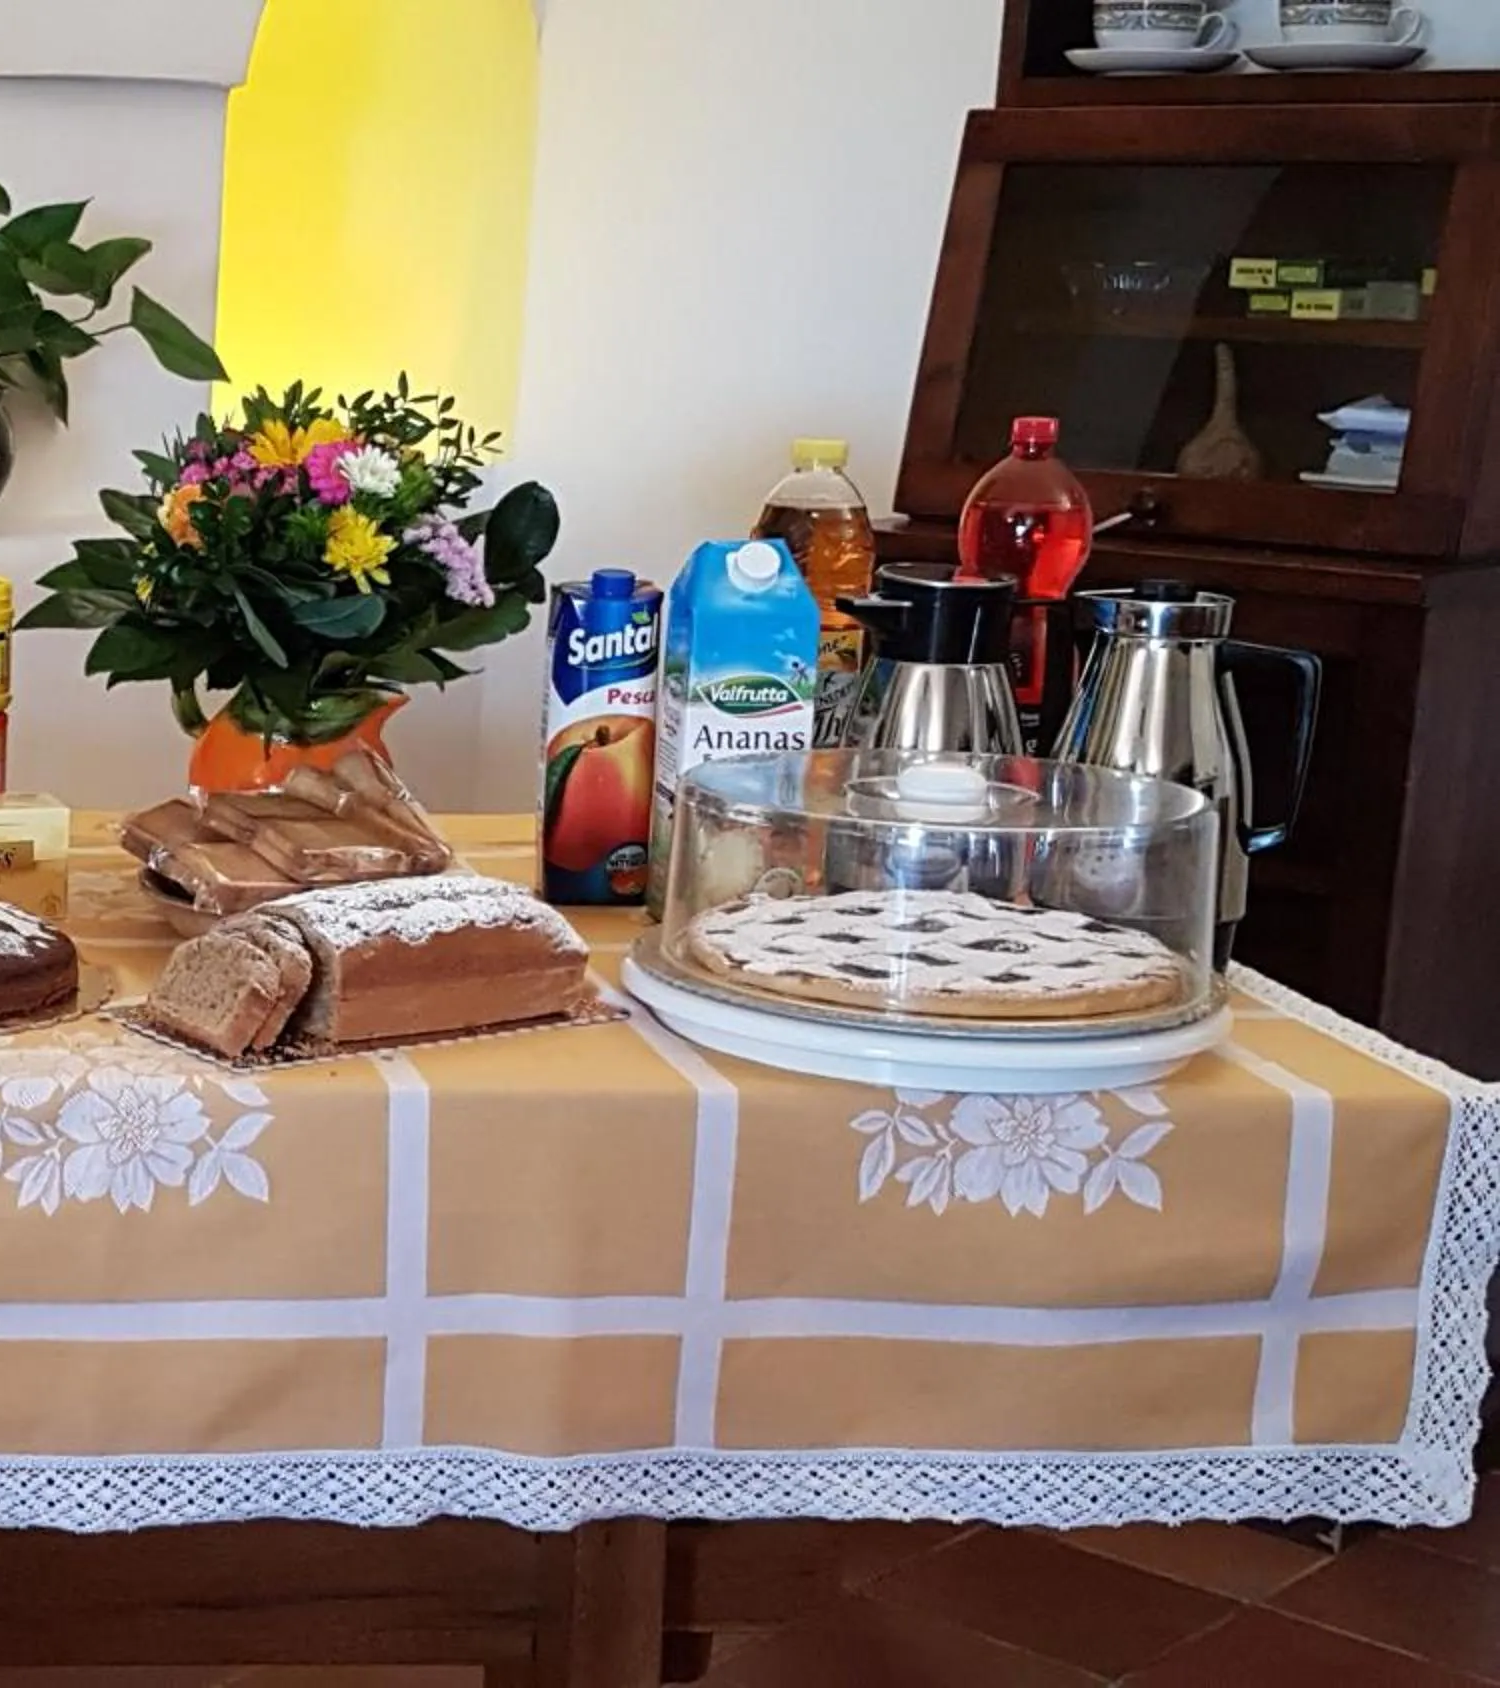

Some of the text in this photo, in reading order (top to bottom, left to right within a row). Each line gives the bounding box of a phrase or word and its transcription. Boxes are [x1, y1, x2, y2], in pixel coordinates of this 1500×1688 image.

[567, 612, 659, 666] Santal
[710, 683, 789, 702] Valfrutta
[693, 724, 805, 751] Ananas
